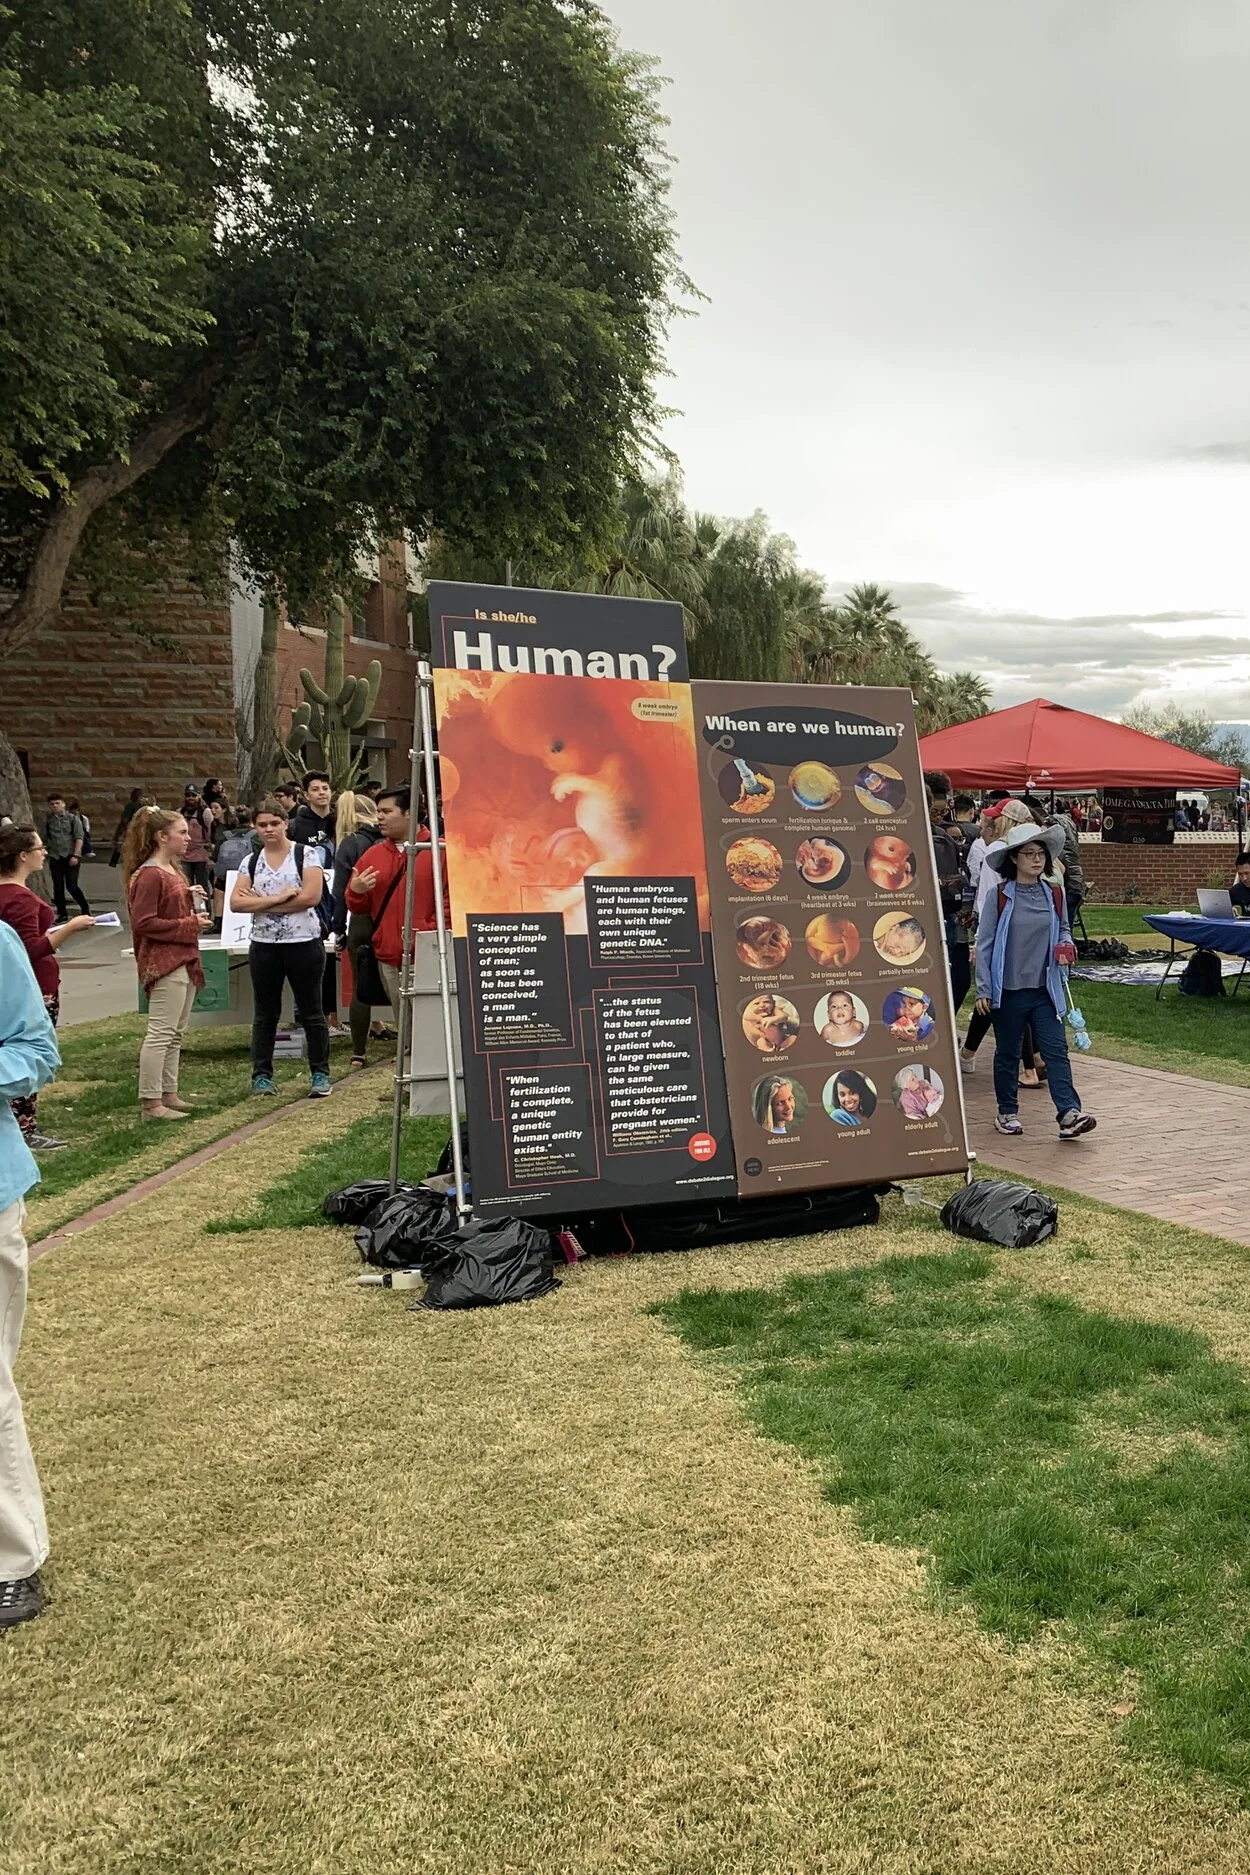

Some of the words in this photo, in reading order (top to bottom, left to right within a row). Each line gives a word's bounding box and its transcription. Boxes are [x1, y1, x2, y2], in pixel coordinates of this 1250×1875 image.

[475, 609, 487, 620] Is
[491, 610, 536, 624] she/he
[453, 630, 677, 682] Human?
[705, 715, 760, 732] When
[767, 719, 796, 733] are
[802, 722, 829, 734] we
[835, 720, 904, 738] human?
[592, 885, 630, 893] "Human
[633, 885, 674, 894] embryos
[652, 906, 686, 915] beings,
[472, 923, 518, 932] "Science
[623, 928, 656, 937] unique
[513, 934, 547, 943] simple
[600, 939, 636, 949] genetic
[640, 938, 668, 947] DNA."
[479, 945, 537, 954] conception
[480, 957, 491, 965] of
[879, 968, 900, 976] partially
[482, 990, 538, 1000] conceived,
[603, 1009, 614, 1017] of
[484, 1015, 493, 1023] is
[650, 1017, 691, 1026] elevated
[618, 1031, 638, 1039] that
[614, 1042, 649, 1052] patient
[619, 1053, 644, 1062] large
[646, 1051, 690, 1060] measure,
[762, 1054, 788, 1063] newborn
[643, 1062, 669, 1073] given
[506, 1076, 539, 1084] "When
[510, 1085, 570, 1096] fertilization
[609, 1085, 664, 1095] meticulous
[523, 1097, 574, 1107] complete,
[634, 1094, 697, 1105] obstetricians
[521, 1110, 556, 1119] unique
[611, 1109, 648, 1120] provide
[512, 1121, 552, 1133] genetic
[612, 1120, 657, 1131] pregnant
[660, 1115, 700, 1126] women."
[513, 1134, 549, 1143] human
[552, 1130, 582, 1140] entity
[838, 1131, 855, 1139] young
[768, 1136, 800, 1145] adolescent
